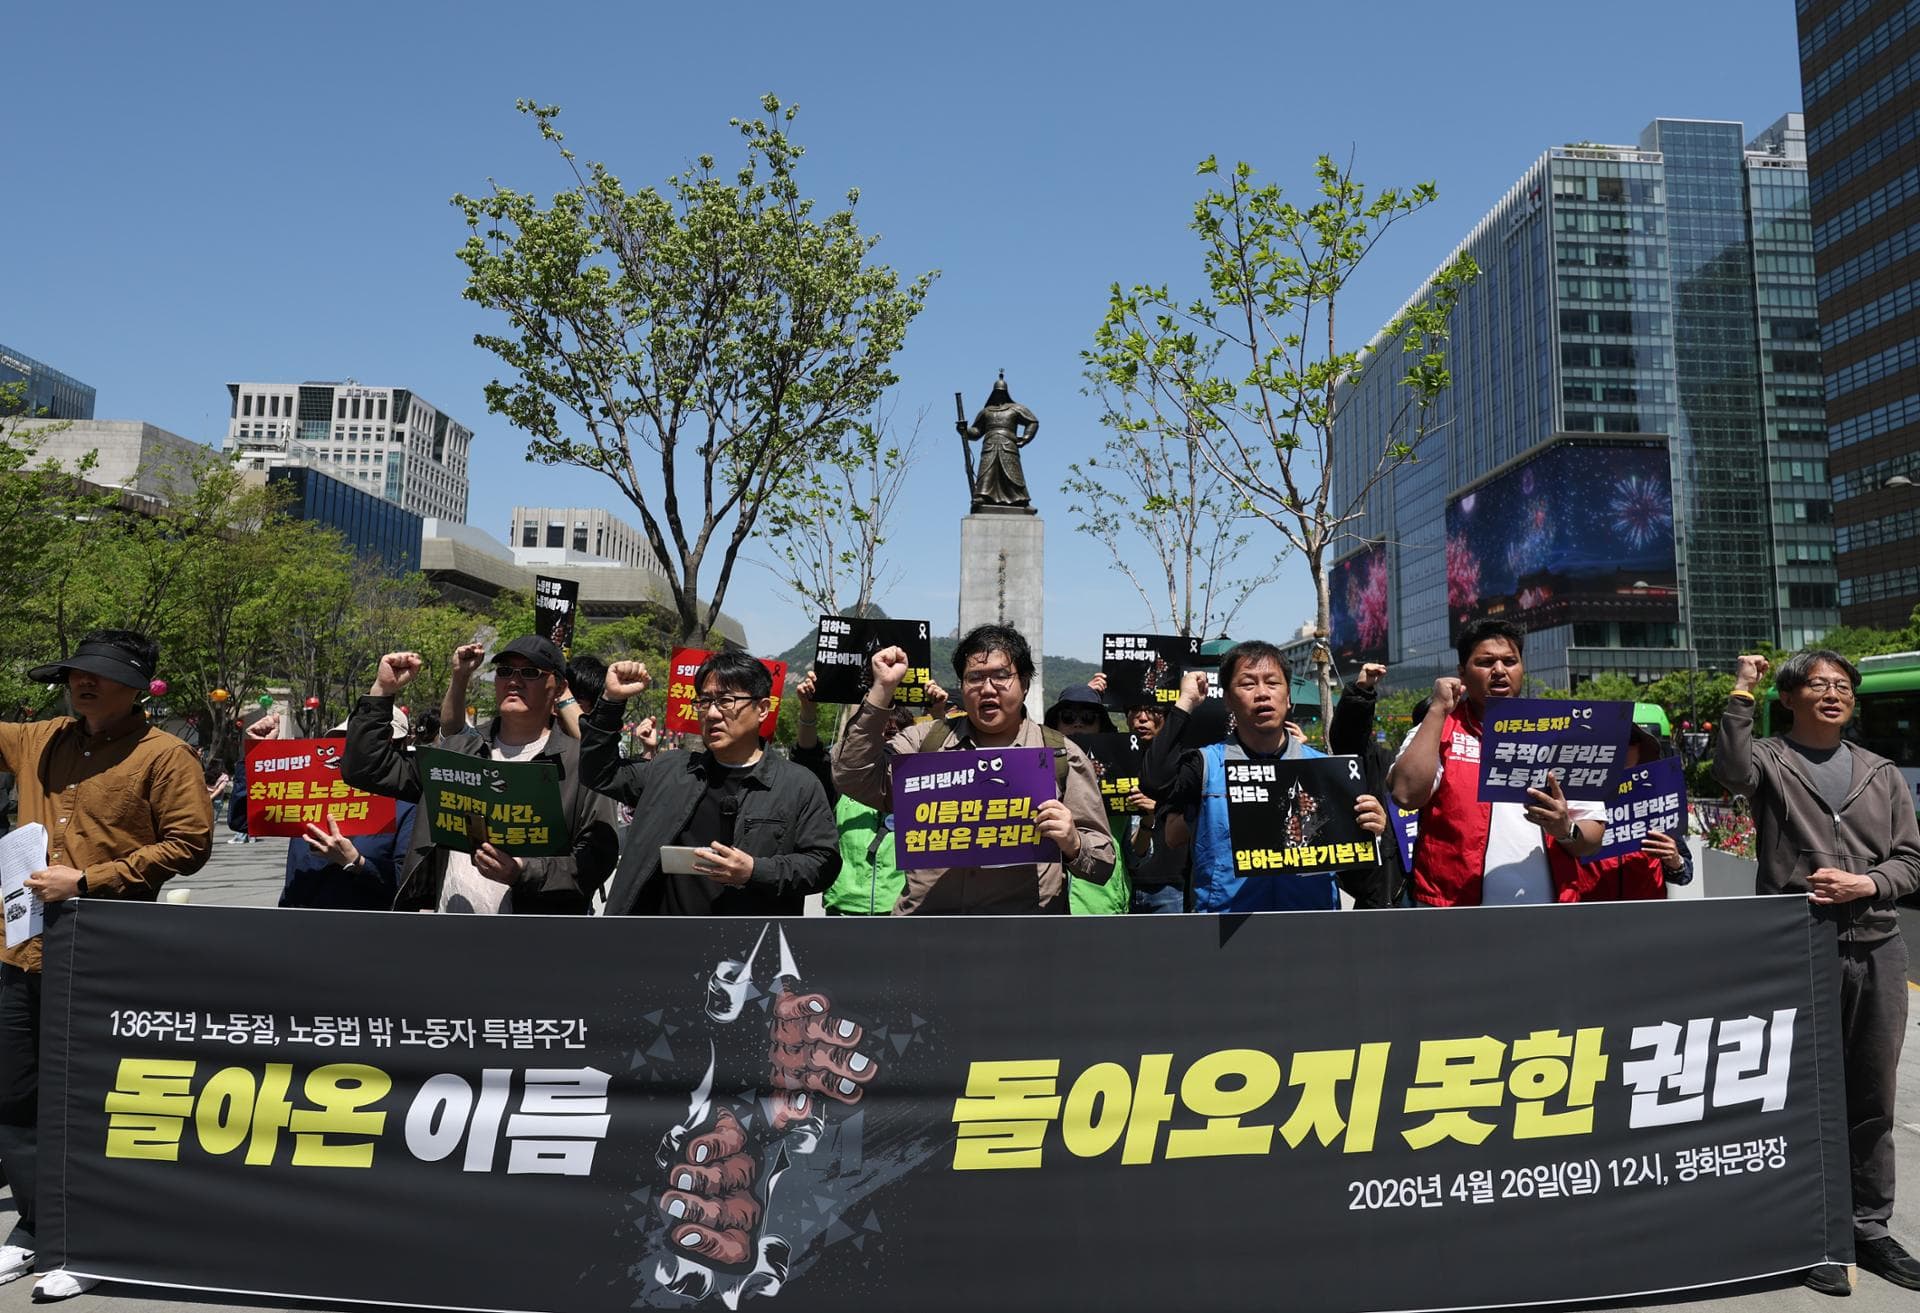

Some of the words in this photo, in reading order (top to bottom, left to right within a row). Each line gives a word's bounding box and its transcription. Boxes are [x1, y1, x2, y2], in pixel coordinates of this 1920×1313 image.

[821, 619, 851, 635] 일하는
[818, 635, 839, 649] 모든
[1104, 637, 1135, 649] 노동법
[1137, 637, 1148, 649] 밖
[816, 650, 863, 666] 사람에게
[1104, 650, 1156, 662] 노동자에게
[901, 667, 930, 684] 동법
[1155, 689, 1180, 703] 권리
[1494, 717, 1571, 733] 이주노동자!
[1495, 742, 1557, 764] 국적이
[1558, 745, 1617, 764] 달라도
[254, 755, 312, 773] 5인미만!
[1227, 765, 1277, 782] 2등국민
[430, 767, 482, 787] 초단시간!
[904, 769, 975, 793] 프리랜서!
[1486, 766, 1566, 789] 노동권은
[1568, 768, 1609, 787] 같다
[249, 781, 305, 800] 숫자로
[1229, 786, 1269, 803] 만드는
[264, 803, 323, 823] 가르지
[327, 801, 369, 821] 말라
[490, 803, 542, 824] 시간,
[915, 799, 983, 825] 이름만
[985, 797, 1038, 821] 프리,
[1633, 792, 1679, 819] 달라도
[487, 826, 549, 845] 노동권
[1601, 820, 1647, 846] 동권은
[1649, 812, 1679, 833] 같다
[905, 827, 972, 853] 현실은
[109, 1010, 196, 1042] 136주년
[201, 1013, 281, 1047] 노동절,
[287, 1014, 360, 1048] 노동법
[367, 1016, 394, 1048] 밖
[399, 1017, 476, 1049] 노동자
[481, 1018, 587, 1050] 특별주간
[951, 1041, 1392, 1170] 돌아오지
[1400, 1026, 1609, 1151] 못한
[1622, 1007, 1798, 1129] 권리
[104, 1057, 393, 1169] 돌아온
[404, 1065, 614, 1176] 이름
[1348, 1174, 1443, 1210] 2026년
[1449, 1169, 1494, 1204] 4월
[1500, 1161, 1601, 1199] 26일(일)
[1608, 1153, 1669, 1189] 12시,
[1674, 1136, 1788, 1180] 광화문광장
